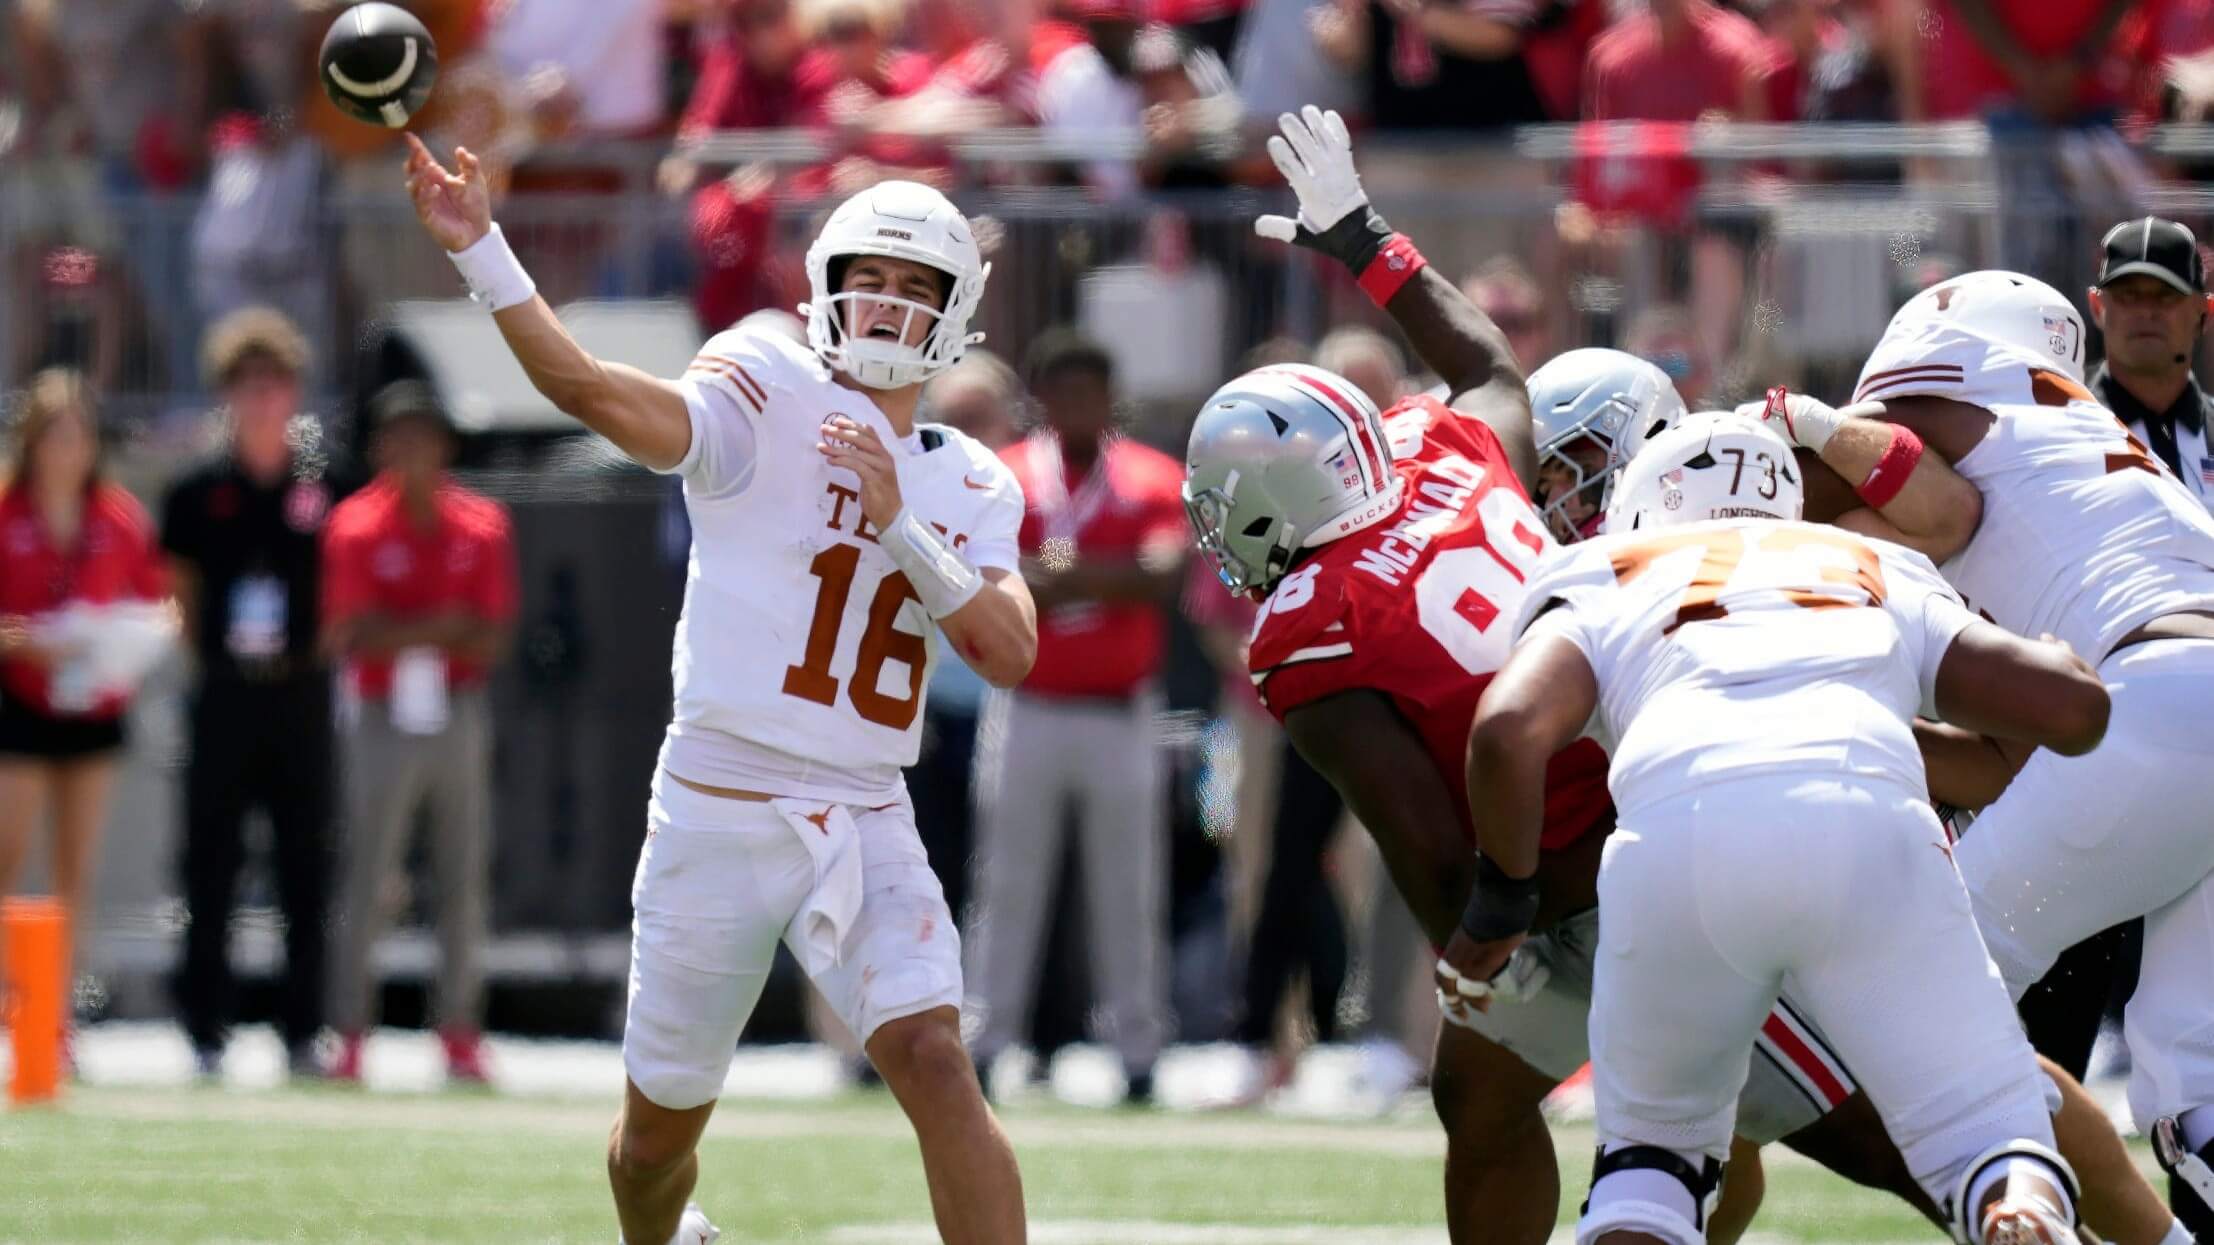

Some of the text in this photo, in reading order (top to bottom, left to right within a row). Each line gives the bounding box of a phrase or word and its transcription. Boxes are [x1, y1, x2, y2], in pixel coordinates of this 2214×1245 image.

[877, 228, 912, 241] HORNS
[1721, 447, 1778, 501] 73
[781, 542, 927, 732] 16
